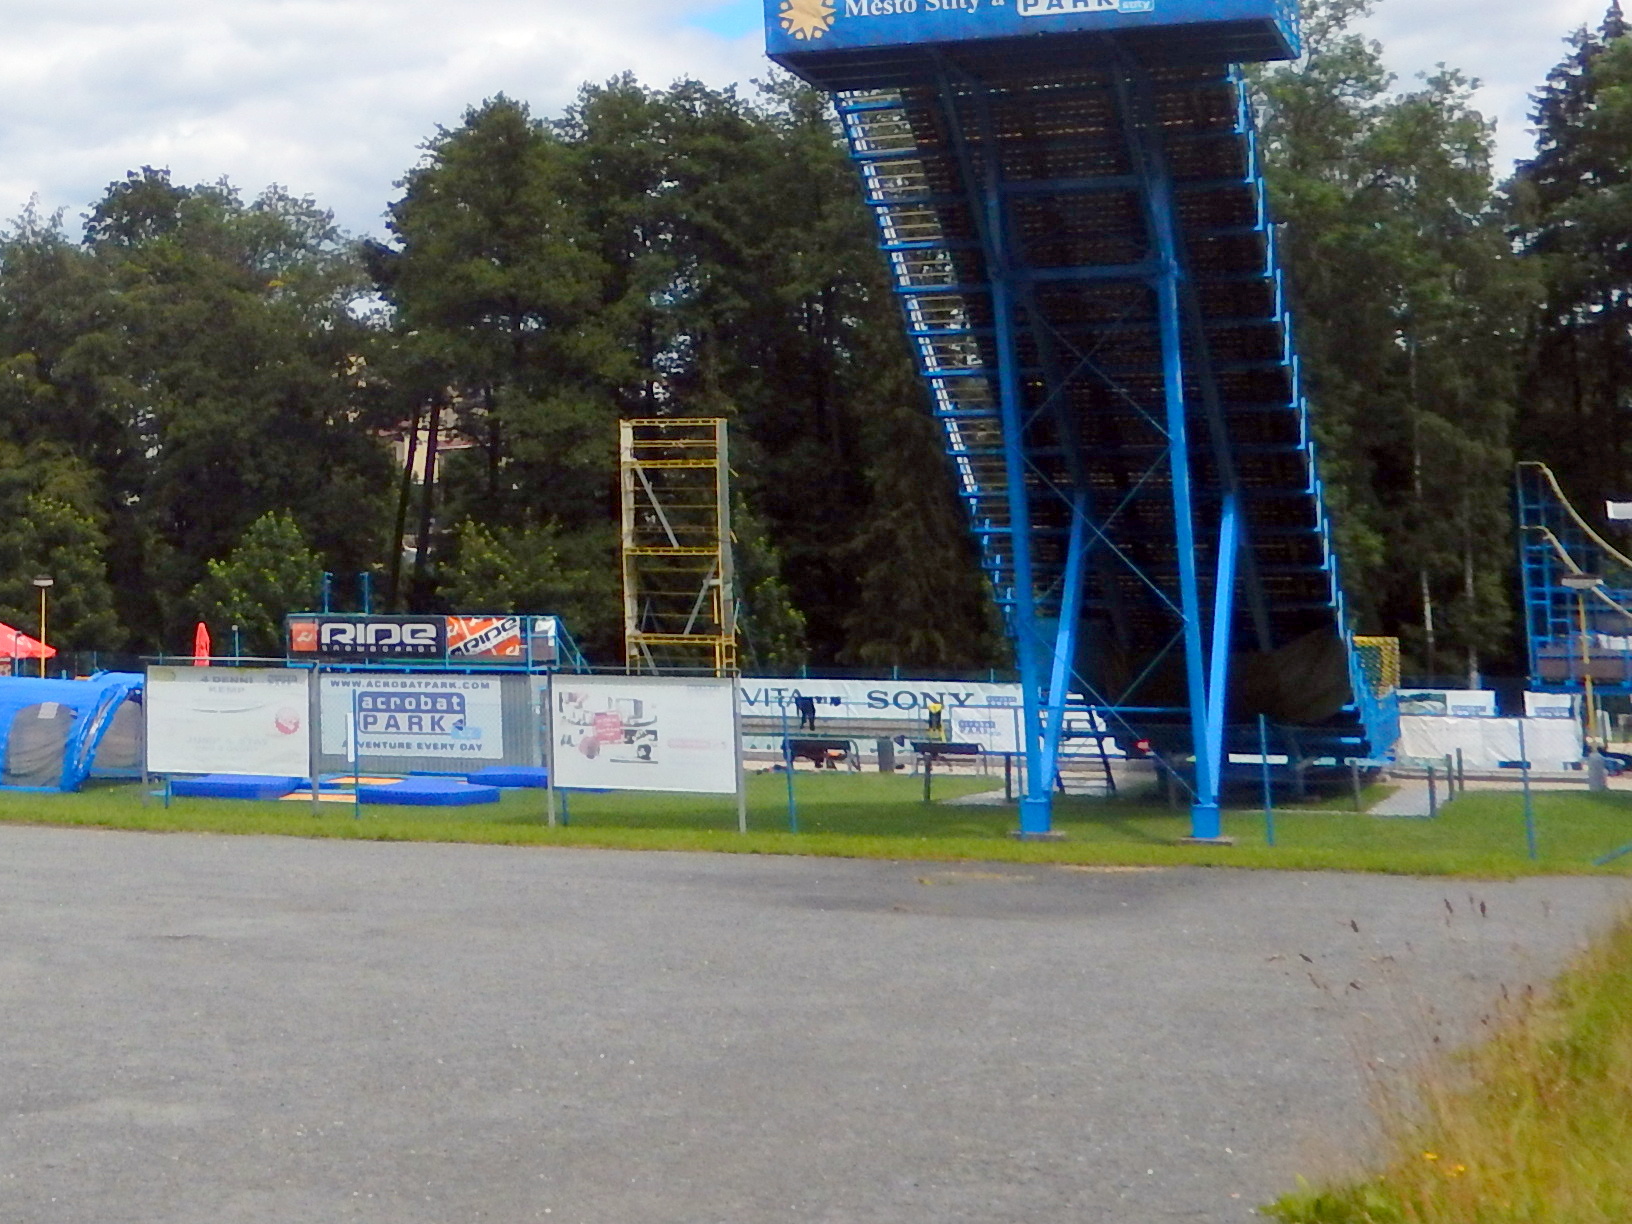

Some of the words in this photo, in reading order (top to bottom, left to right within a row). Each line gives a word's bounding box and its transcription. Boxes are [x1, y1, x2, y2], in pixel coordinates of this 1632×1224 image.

[322, 623, 437, 644] RIDE
[330, 680, 490, 690] WWW.ACROBATPARK.COM
[361, 695, 461, 711] acrobat
[867, 690, 974, 710] SONY
[363, 714, 446, 732] PARK
[342, 740, 412, 750] AVENTURE
[417, 742, 455, 751] EVERY
[460, 743, 482, 752] DAY
